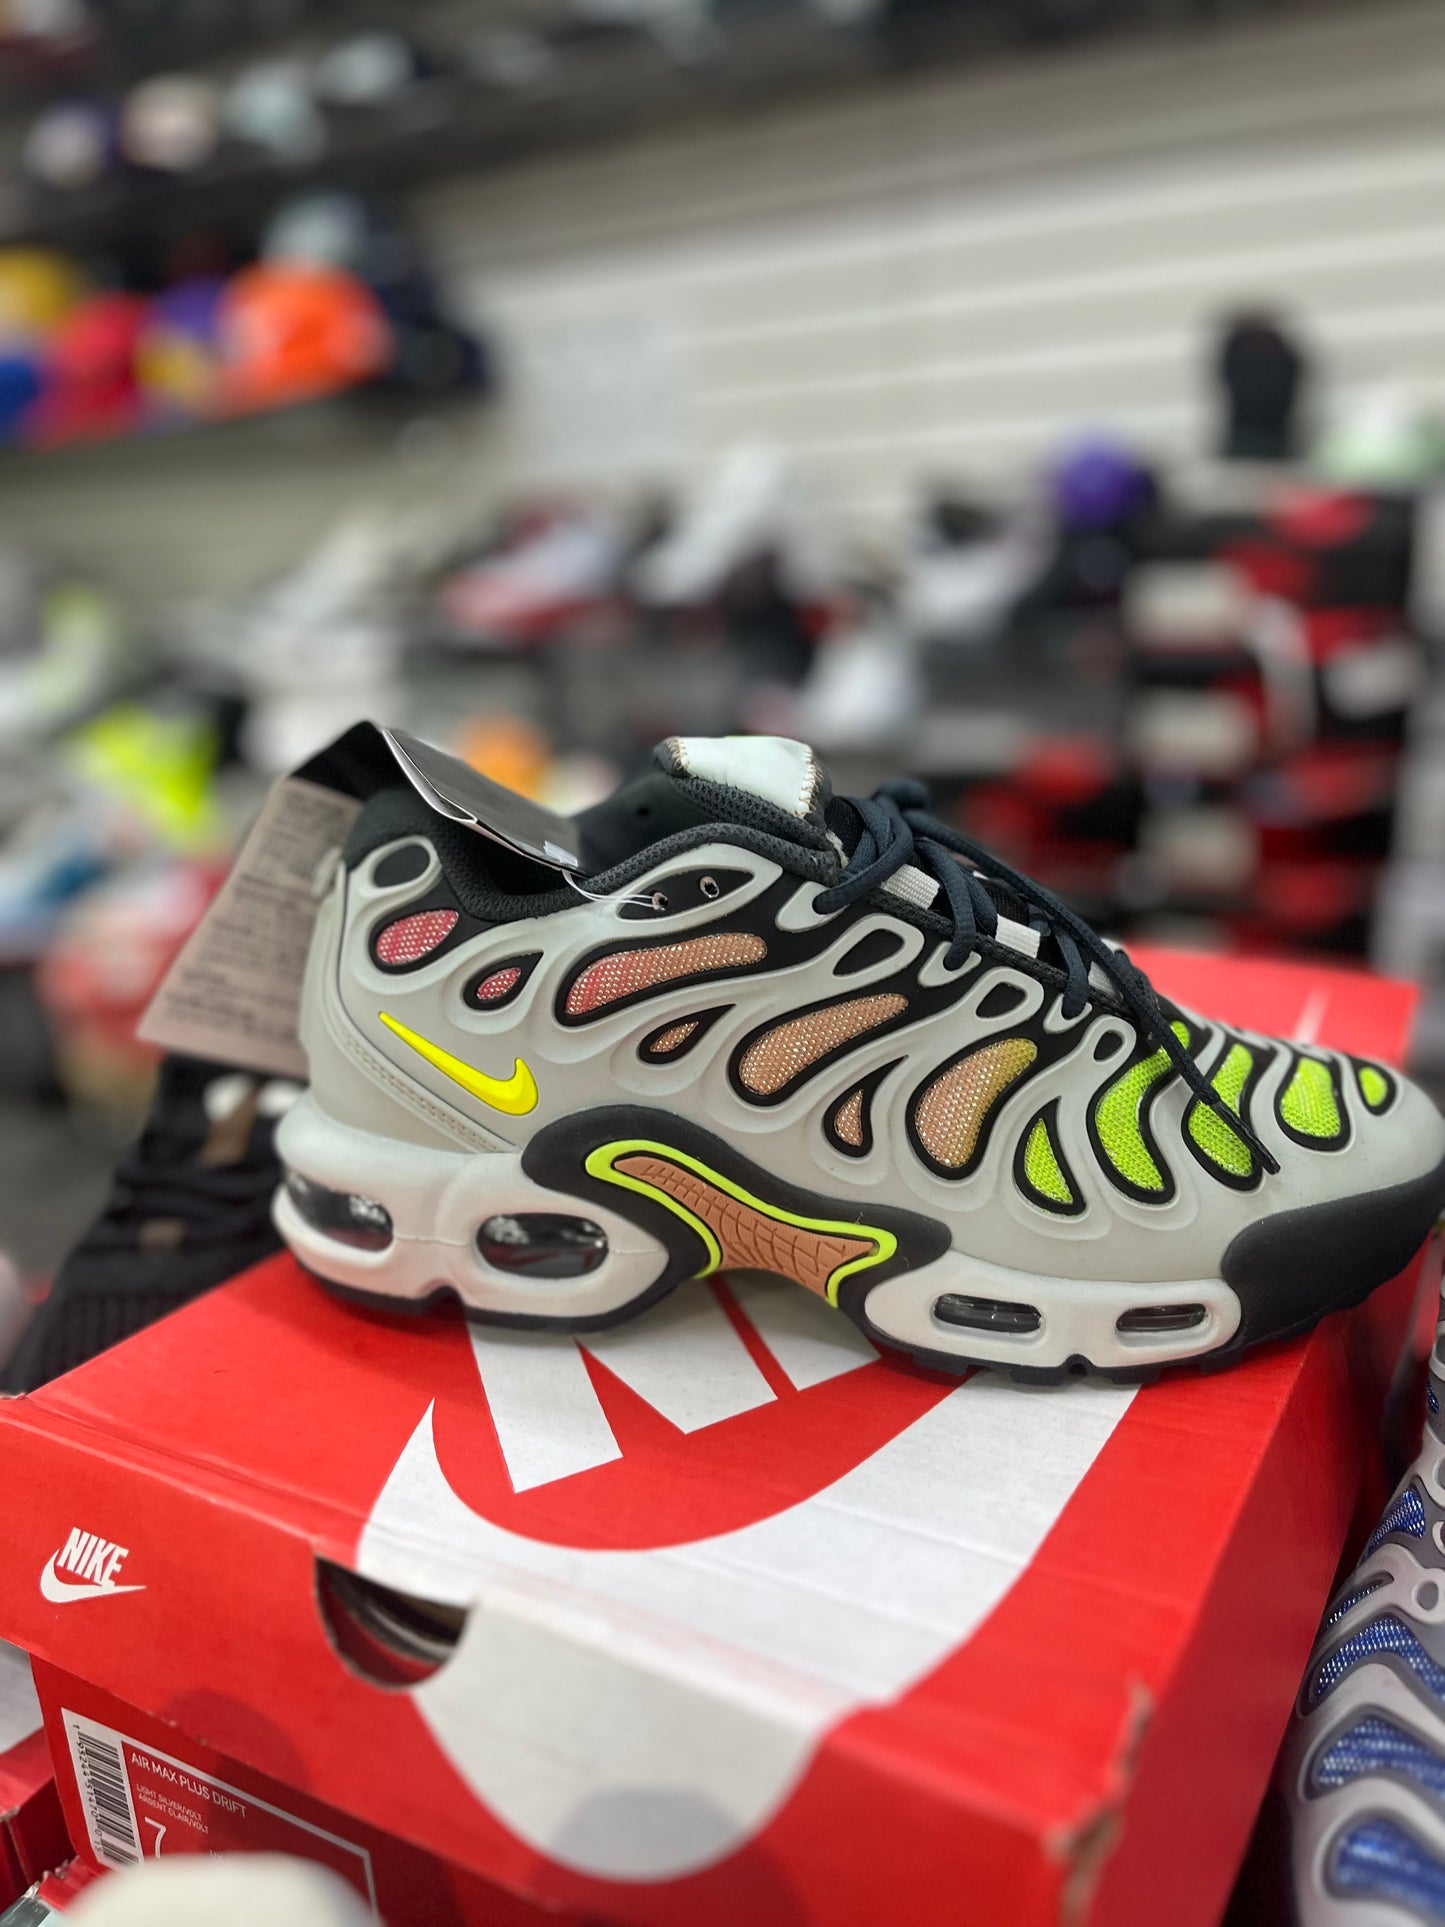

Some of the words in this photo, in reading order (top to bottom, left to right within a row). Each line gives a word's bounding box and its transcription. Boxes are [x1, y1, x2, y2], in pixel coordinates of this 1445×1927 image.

[56, 1526, 129, 1588] NIKE
[131, 1752, 151, 1771] AIR
[152, 1761, 178, 1784] MAX
[179, 1775, 211, 1800] PLUS
[212, 1791, 247, 1818] DRIFT
